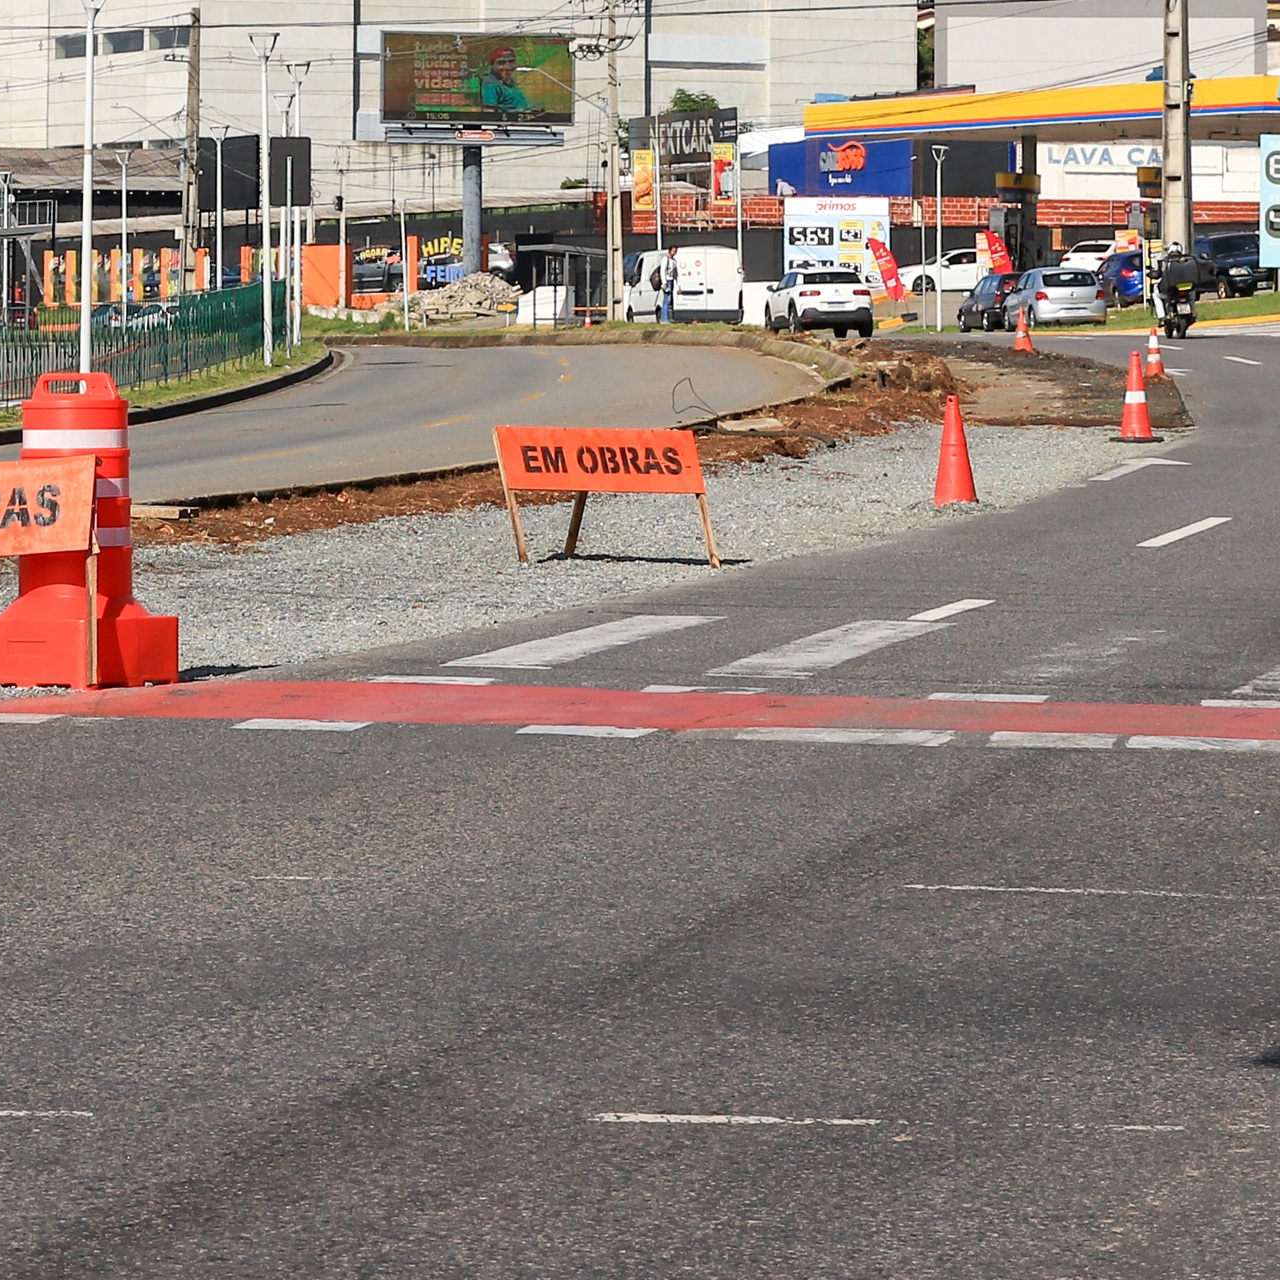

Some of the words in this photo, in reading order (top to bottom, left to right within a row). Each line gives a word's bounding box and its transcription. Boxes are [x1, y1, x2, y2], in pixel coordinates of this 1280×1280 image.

[413, 77, 463, 90] vidas
[649, 117, 715, 156] NEXTCARS
[1047, 147, 1114, 166] LAVA
[359, 248, 389, 260] AGORA
[521, 445, 569, 474] EM
[576, 445, 683, 475] OBRAS
